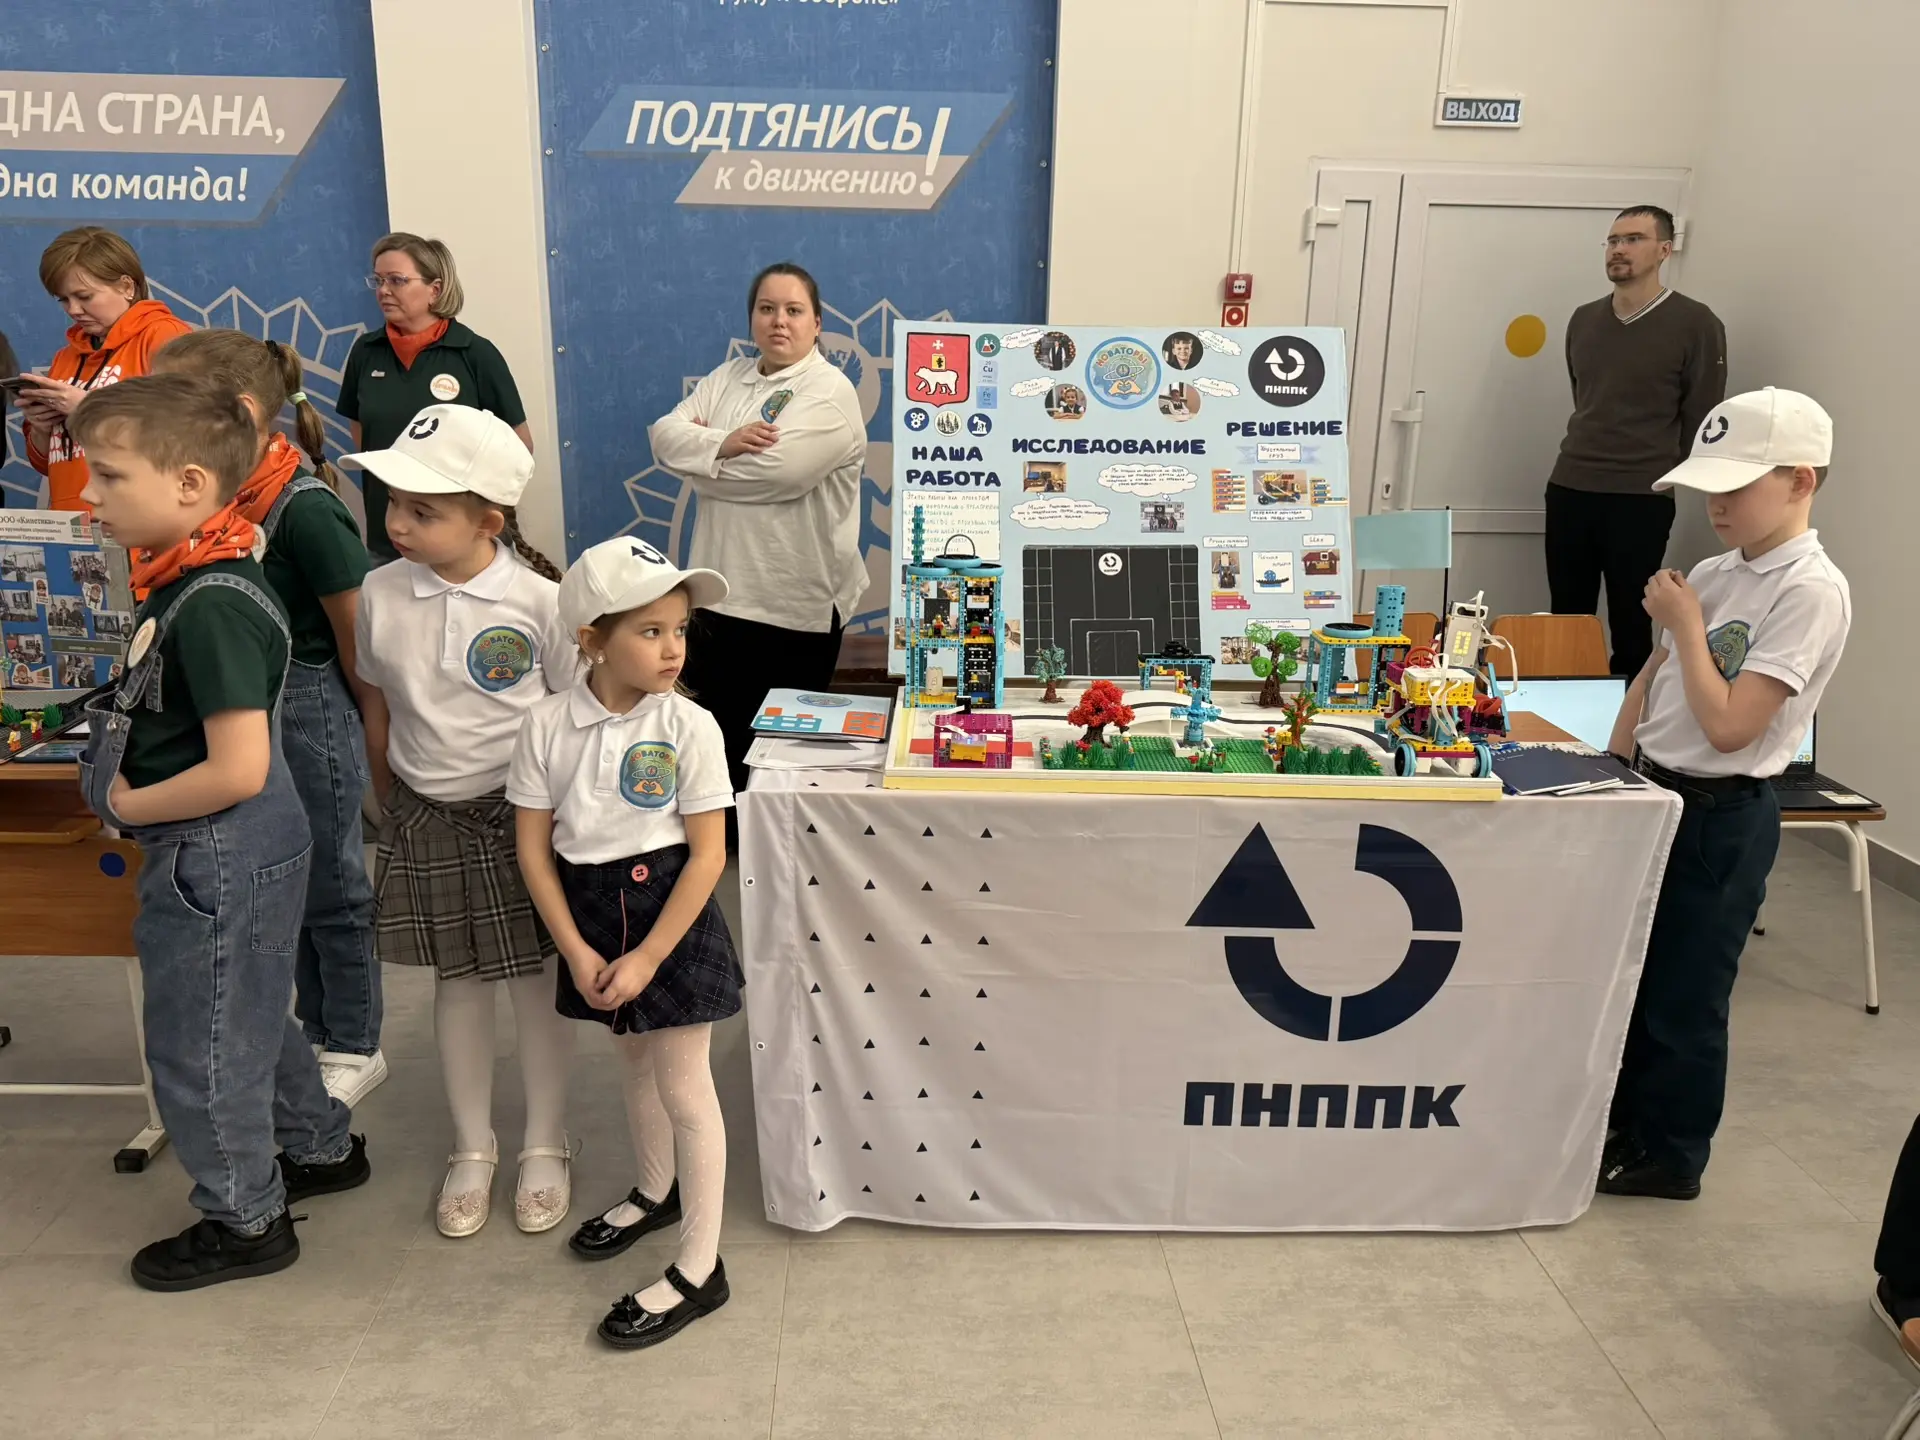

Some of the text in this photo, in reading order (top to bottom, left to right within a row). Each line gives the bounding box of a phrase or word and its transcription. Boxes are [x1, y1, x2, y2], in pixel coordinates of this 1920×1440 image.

[97, 92, 286, 144] СТРАНА,
[1446, 101, 1516, 121] ВЫХОД
[71, 166, 248, 202] команда!
[714, 159, 917, 195] к движению
[1095, 346, 1148, 367] НОВАТОРЫ
[982, 365, 994, 373] Cu
[1264, 384, 1308, 395] ПНППК
[1226, 420, 1343, 437] РЕШЕНИЕ
[911, 446, 984, 462] НАША
[1012, 438, 1206, 455] ИССЛЕДОВАНИЕ
[906, 469, 1002, 487] РАБОТА
[1184, 1081, 1467, 1130] ПНППК
